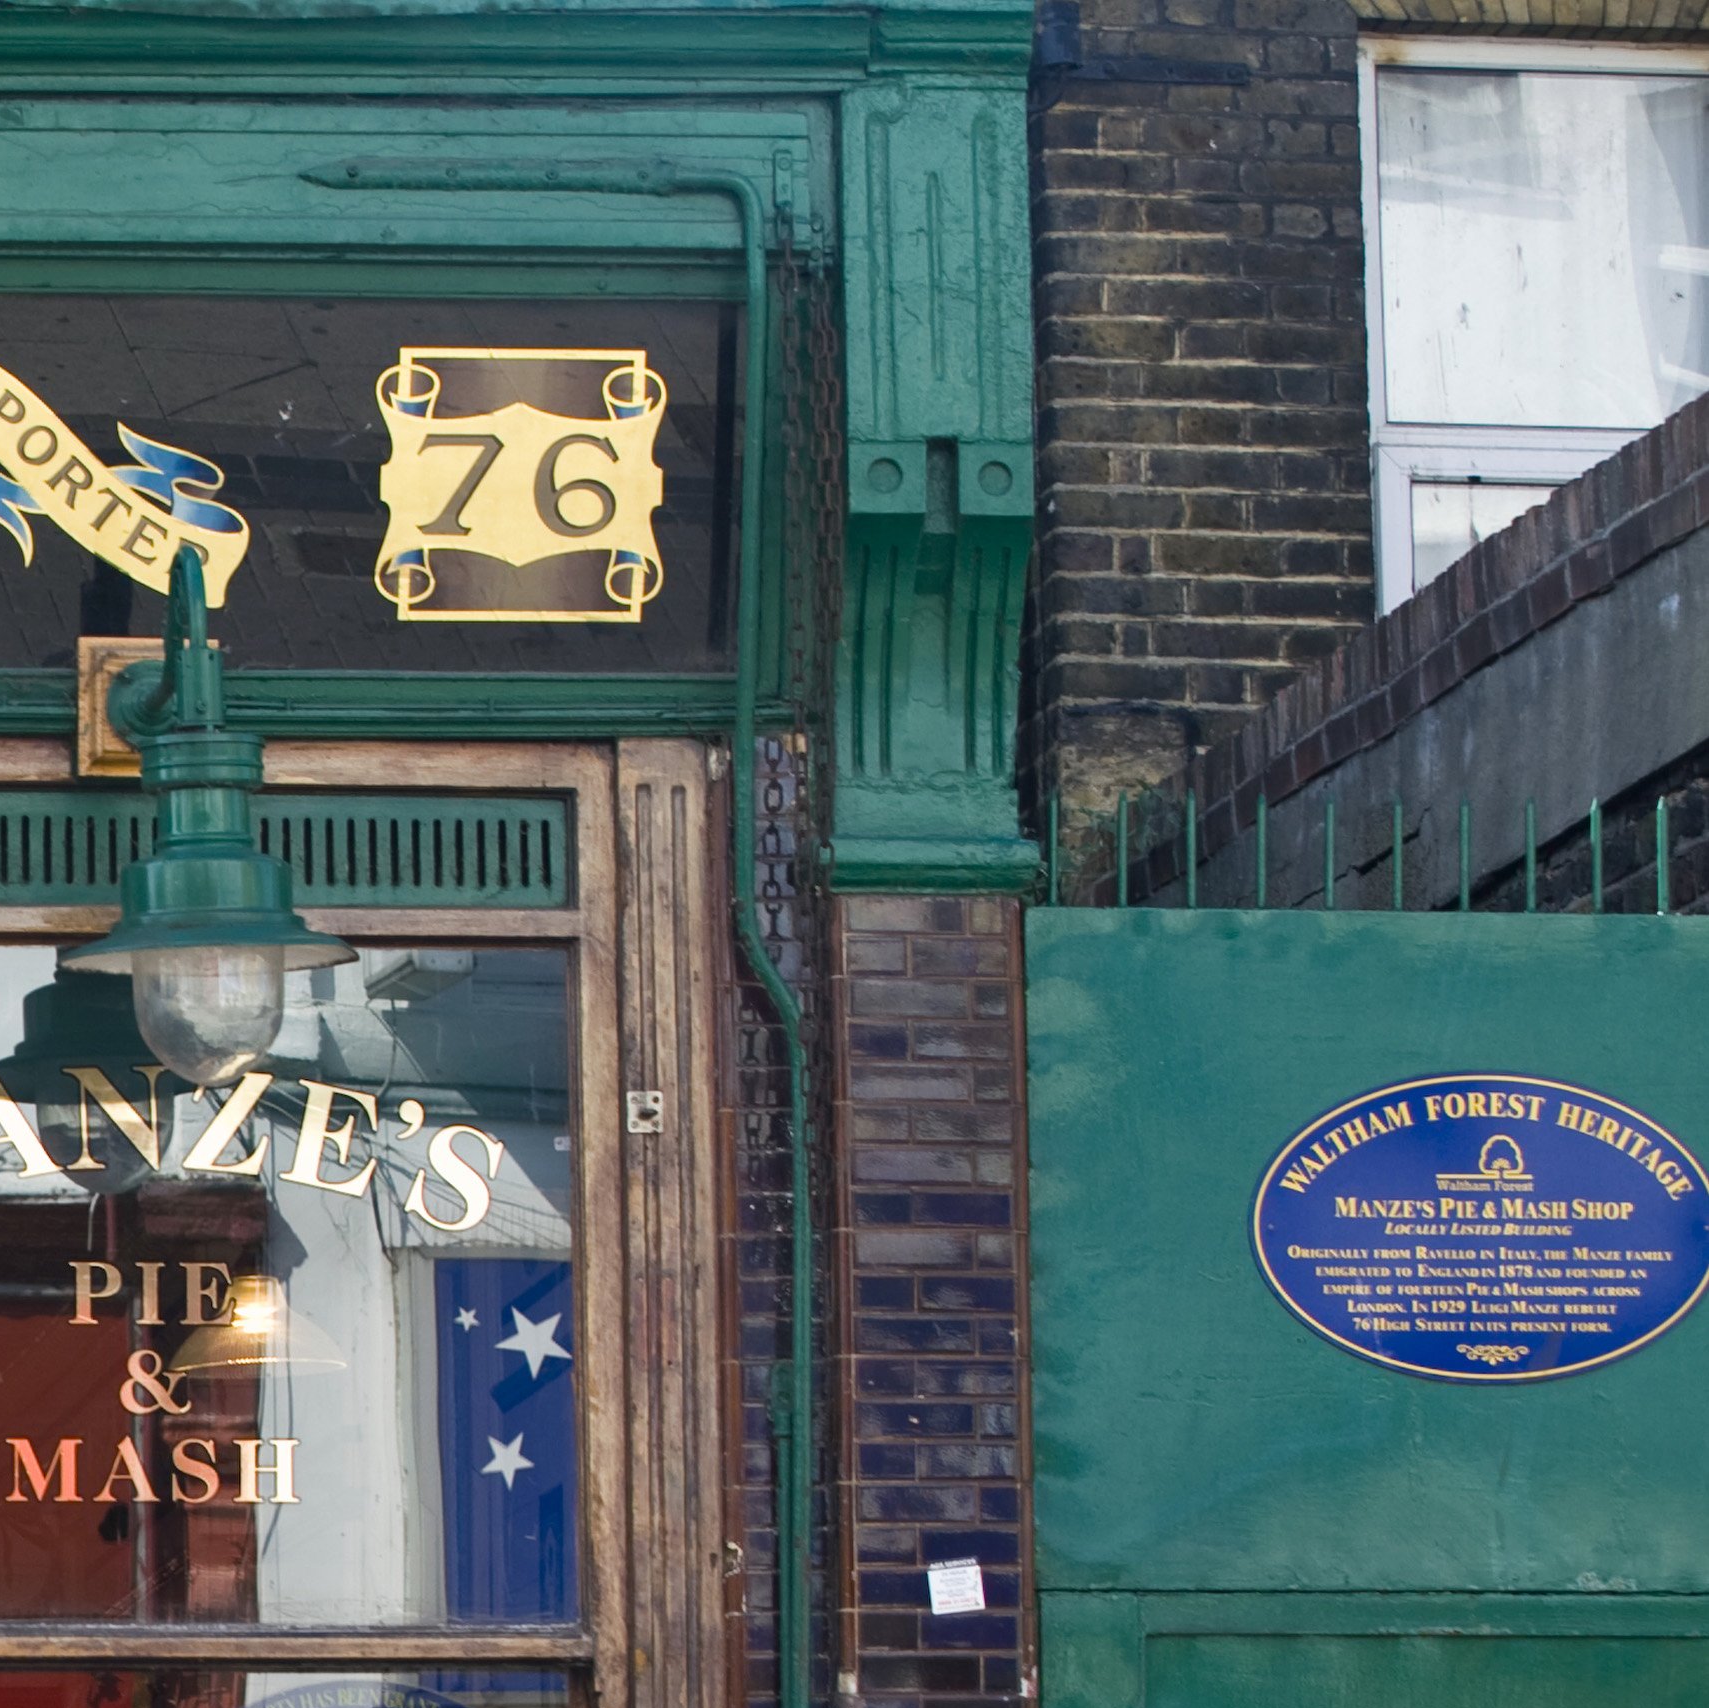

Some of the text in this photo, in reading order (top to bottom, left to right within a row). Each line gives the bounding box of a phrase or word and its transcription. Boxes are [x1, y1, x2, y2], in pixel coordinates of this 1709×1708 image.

[415, 433, 620, 537] 76
[1279, 1092, 1694, 1200] WALTHAM FOREST HERITAGE
[1436, 1179, 1534, 1191] Waltham Forest
[1439, 1198, 1478, 1218] PIE
[1482, 1201, 1497, 1219] &
[1501, 1198, 1568, 1219] MASH
[1572, 1198, 1634, 1220] SHOP
[1499, 1264, 1533, 1278] 1878
[68, 1261, 237, 1326] PIE
[1432, 1299, 1467, 1313] 1929
[1352, 1317, 1370, 1331] 76
[120, 1349, 192, 1416] &
[5, 1437, 301, 1504] MASH
